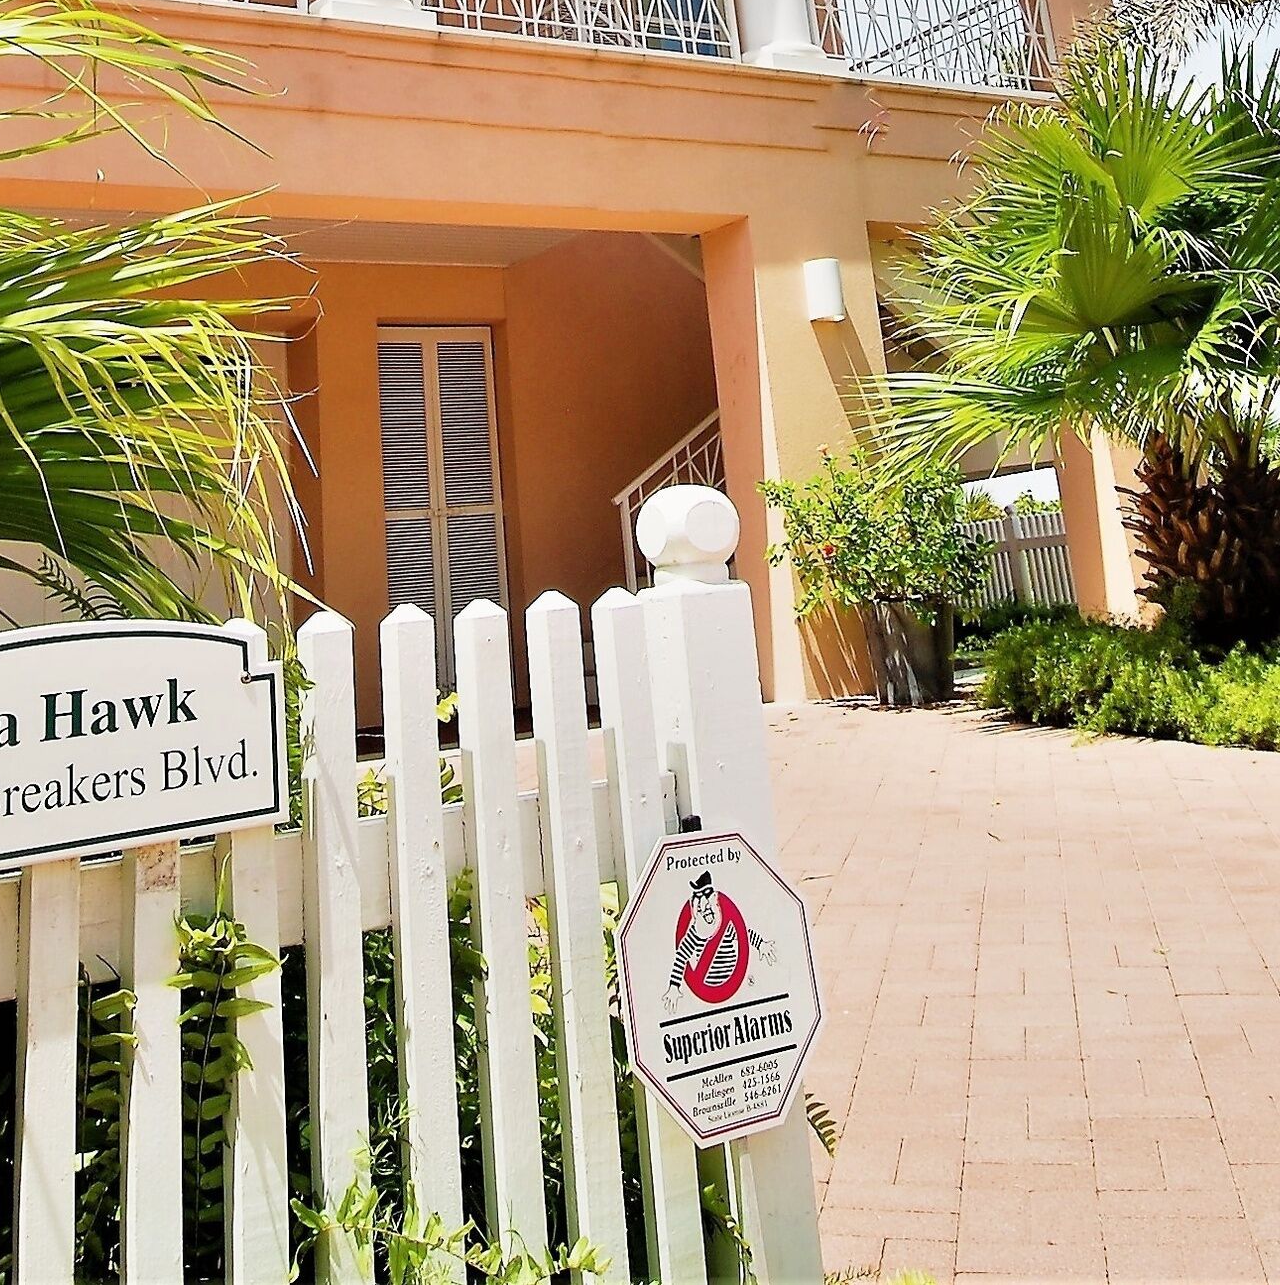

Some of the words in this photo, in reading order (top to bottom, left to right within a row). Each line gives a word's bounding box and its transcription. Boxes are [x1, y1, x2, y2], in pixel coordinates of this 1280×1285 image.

[39, 678, 199, 743] Hawk
[159, 739, 259, 791] Blvd.
[666, 849, 724, 871] Protected
[727, 847, 741, 863] by
[663, 1022, 731, 1064] Superior
[733, 1009, 793, 1044] Alarms
[701, 1073, 733, 1088] McAllen
